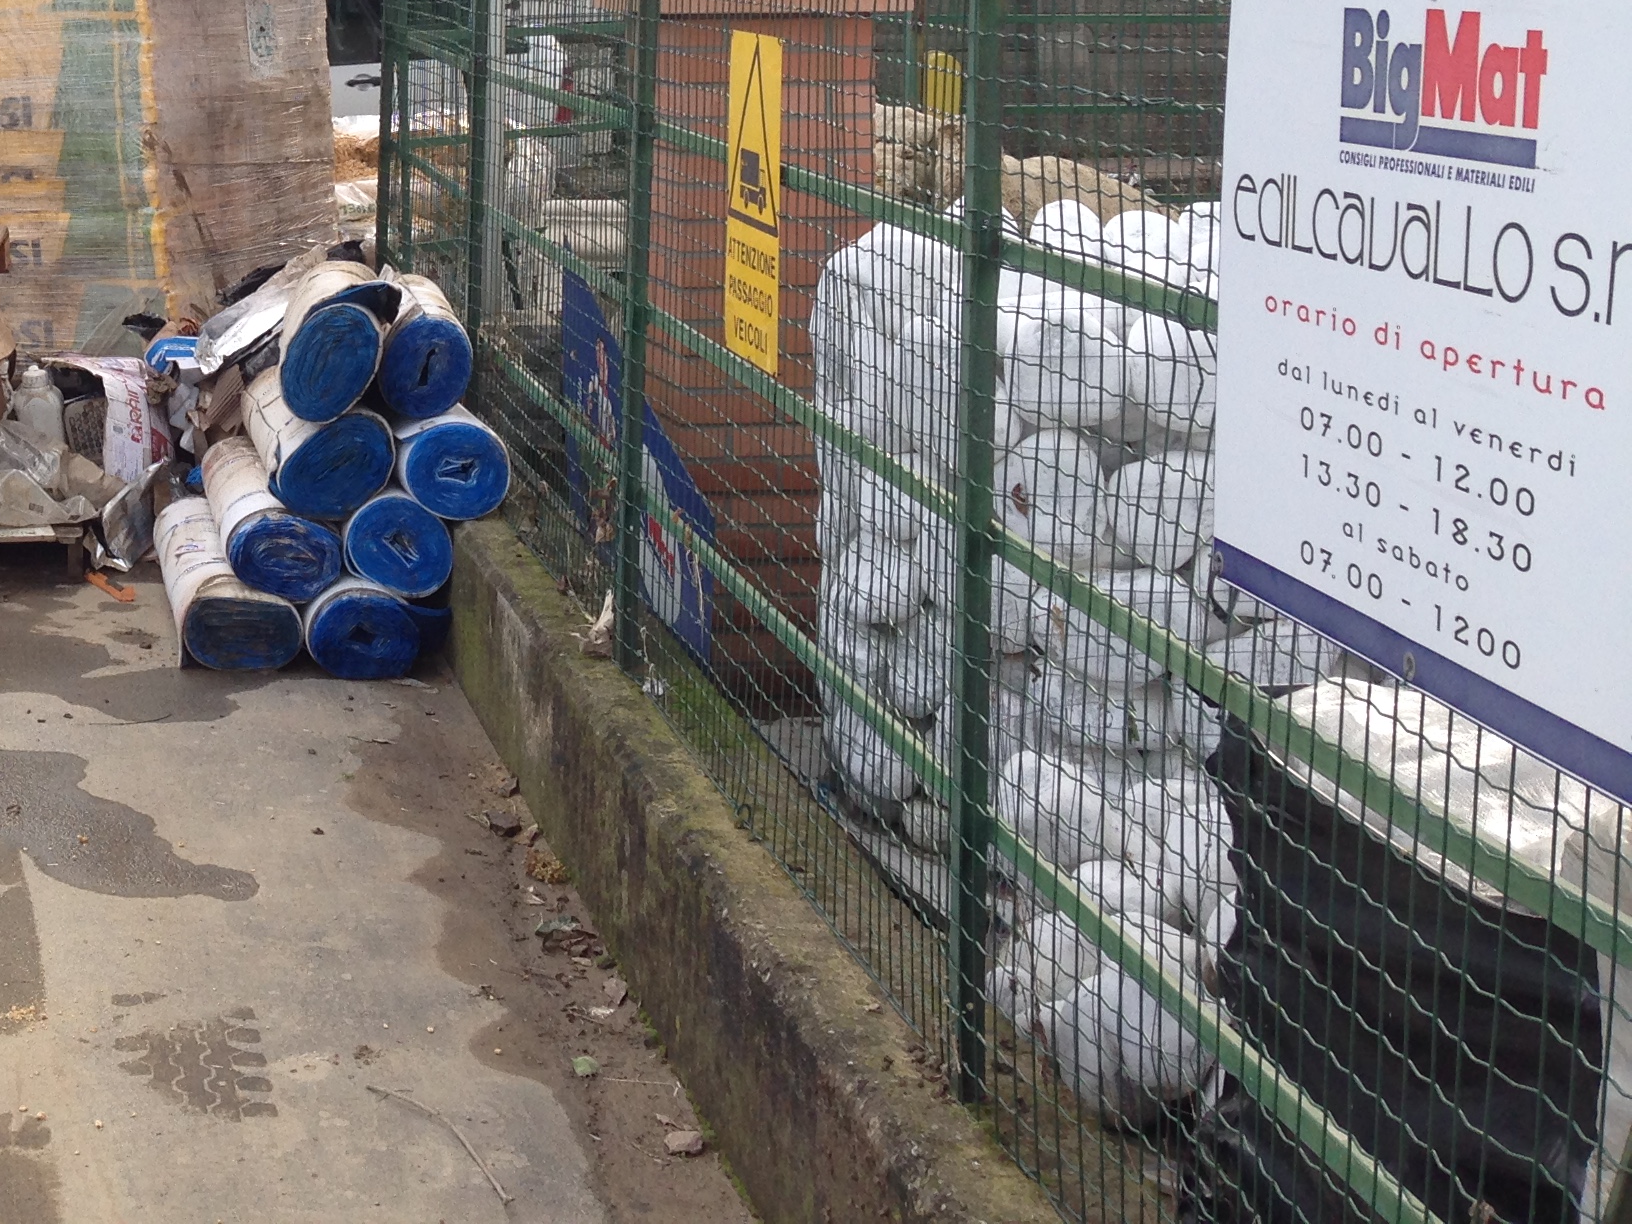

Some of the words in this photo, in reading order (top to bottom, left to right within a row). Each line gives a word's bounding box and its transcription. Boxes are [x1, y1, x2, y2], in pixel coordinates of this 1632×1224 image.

[1341, 7, 1548, 151] BigMat
[1339, 150, 1376, 168] CONSIGLI
[1378, 155, 1445, 178] PROFESSIONALI
[1447, 167, 1453, 180] E
[1455, 167, 1506, 188] MATERIALI
[1508, 176, 1535, 193] EDILI
[728, 237, 776, 280] ATTENZIONE
[729, 274, 773, 317] PASSAGGIO
[734, 315, 768, 355] VEICOLI
[1265, 296, 1356, 336] orario
[1374, 322, 1400, 350] di
[1420, 340, 1605, 410] apertura
[1278, 359, 1310, 384] dal
[1323, 371, 1400, 415] lunedi
[1414, 408, 1437, 428] al
[1454, 421, 1576, 476] venerdi
[1301, 407, 1382, 457] 07.00
[1435, 456, 1535, 516] 12.00
[1303, 454, 1380, 507] 13.30
[1433, 508, 1531, 572] 18.30
[1343, 523, 1363, 542] al
[1377, 538, 1469, 591] sabato
[1301, 541, 1383, 599] 07.00
[1435, 604, 1521, 670] 1200
